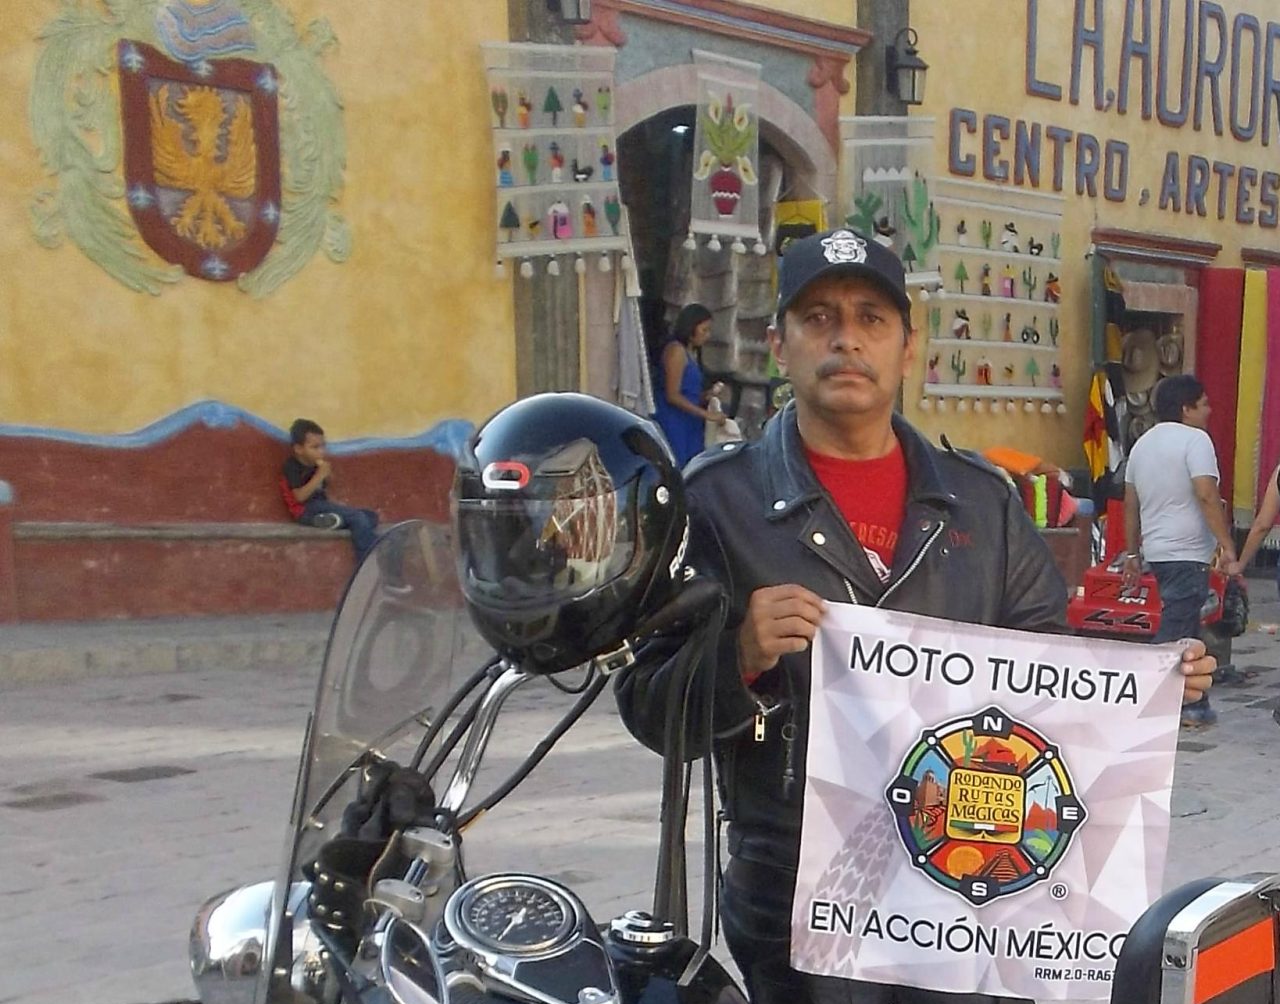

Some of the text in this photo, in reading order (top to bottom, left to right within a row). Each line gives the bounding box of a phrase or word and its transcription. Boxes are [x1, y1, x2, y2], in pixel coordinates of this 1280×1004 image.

[948, 107, 1129, 202] CENTRO
[849, 635, 1139, 705] MOTO TURISTA
[982, 716, 1003, 732] N
[892, 788, 911, 804] O
[1061, 806, 1078, 821] E
[971, 881, 988, 897] S
[810, 901, 854, 936] EN
[861, 909, 998, 956] ACCIÓN
[1034, 967, 1116, 982] RRM 2.0-RA6
